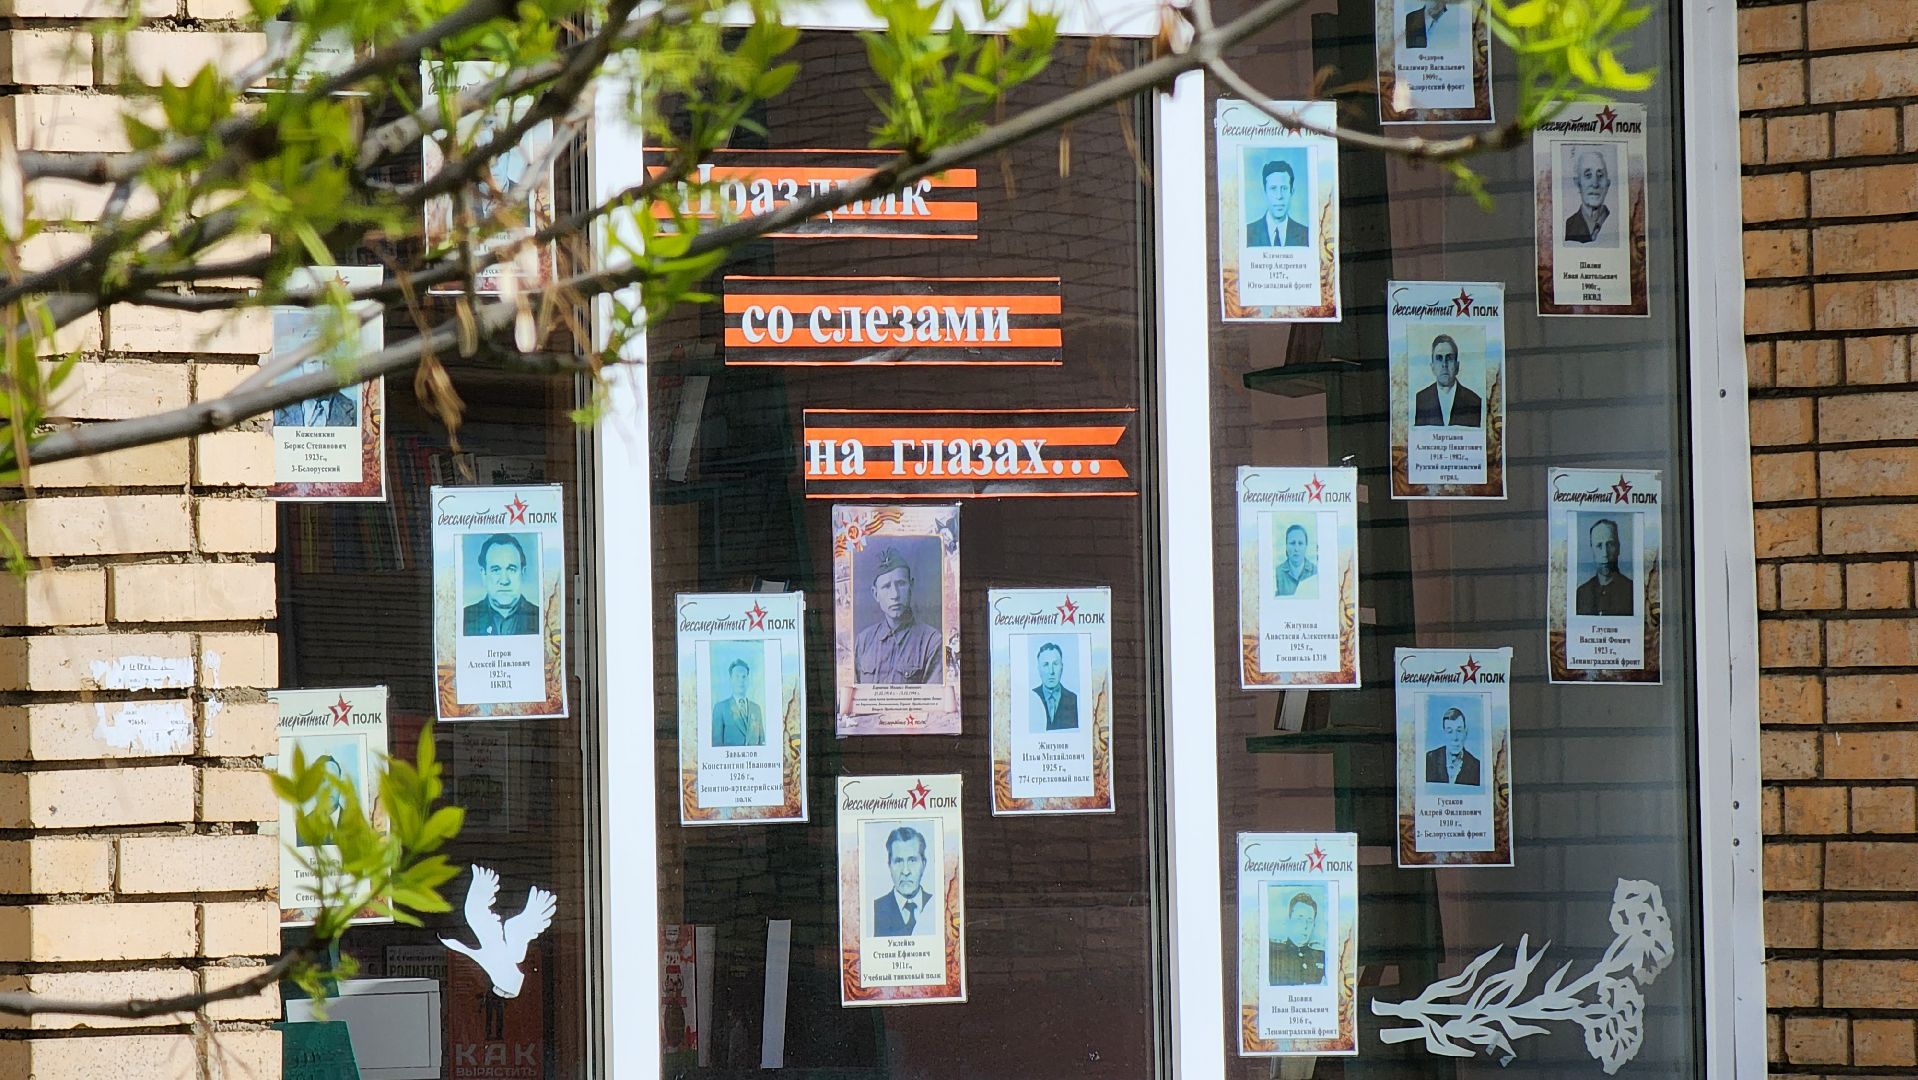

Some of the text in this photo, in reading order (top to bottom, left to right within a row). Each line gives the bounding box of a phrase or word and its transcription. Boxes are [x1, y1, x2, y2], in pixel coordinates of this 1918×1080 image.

[1398, 64, 1427, 72] Владимир
[1447, 84, 1465, 92] фронт
[1251, 262, 1307, 270] Виктор Андреевич
[1563, 272, 1578, 280] Иван
[1294, 282, 1312, 290] фронт
[1583, 293, 1602, 301] НКВД
[741, 304, 1011, 343] со слезами
[1432, 434, 1464, 442] Мартынов
[284, 442, 304, 451] Борис
[1416, 444, 1447, 452] Александр
[806, 438, 1100, 476] на глазах...
[1440, 463, 1482, 472] партизанский
[1265, 633, 1338, 641] Анастасия Алексеевна
[1580, 636, 1607, 644] Василий
[487, 650, 511, 658] Петров
[1276, 654, 1311, 662] Госпиталь
[497, 660, 530, 668] Павлович
[1570, 657, 1640, 667] Ленинградский фронт
[490, 681, 512, 689] НКВД
[1038, 742, 1069, 751] Жигунов
[1022, 753, 1085, 761] Илья Михайлович
[702, 761, 781, 771] Константин Иванович
[730, 773, 745, 781] 1926
[1031, 775, 1072, 785] стрелковый
[1437, 798, 1463, 806] Гусаков
[1419, 809, 1442, 818] Андрей
[1425, 830, 1465, 839] Белорусский
[1467, 830, 1486, 839] фронт
[873, 951, 931, 960] Степан Ефимович
[863, 974, 892, 982] Учебный
[1272, 1006, 1289, 1014] Иван
[1265, 1028, 1337, 1037] Ленинградский фронт
[455, 1044, 536, 1066] КАК
[456, 1067, 537, 1077] ВЫРАСТИТЬ
